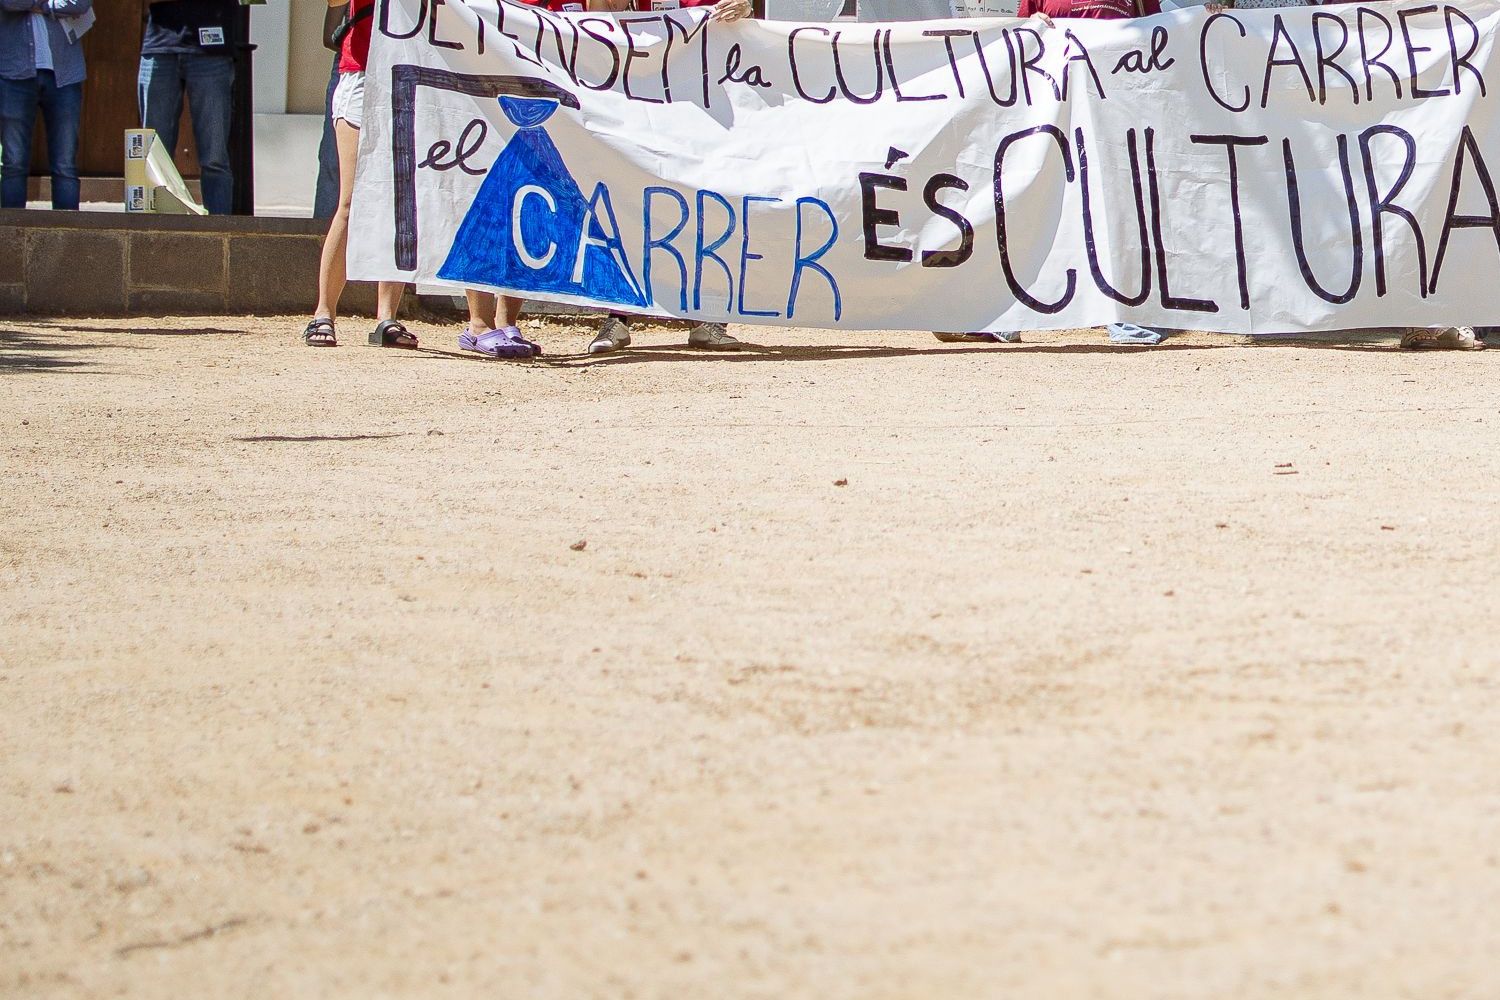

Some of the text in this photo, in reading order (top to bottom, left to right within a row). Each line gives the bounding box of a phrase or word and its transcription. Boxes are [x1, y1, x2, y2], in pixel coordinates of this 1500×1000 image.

[718, 42, 771, 88] la
[788, 26, 1106, 107] CULTURA
[1111, 26, 1175, 75] al
[1200, 5, 1487, 112] CARRER
[418, 118, 488, 176] el
[512, 181, 843, 321] CARRER
[859, 145, 975, 268] ÉS
